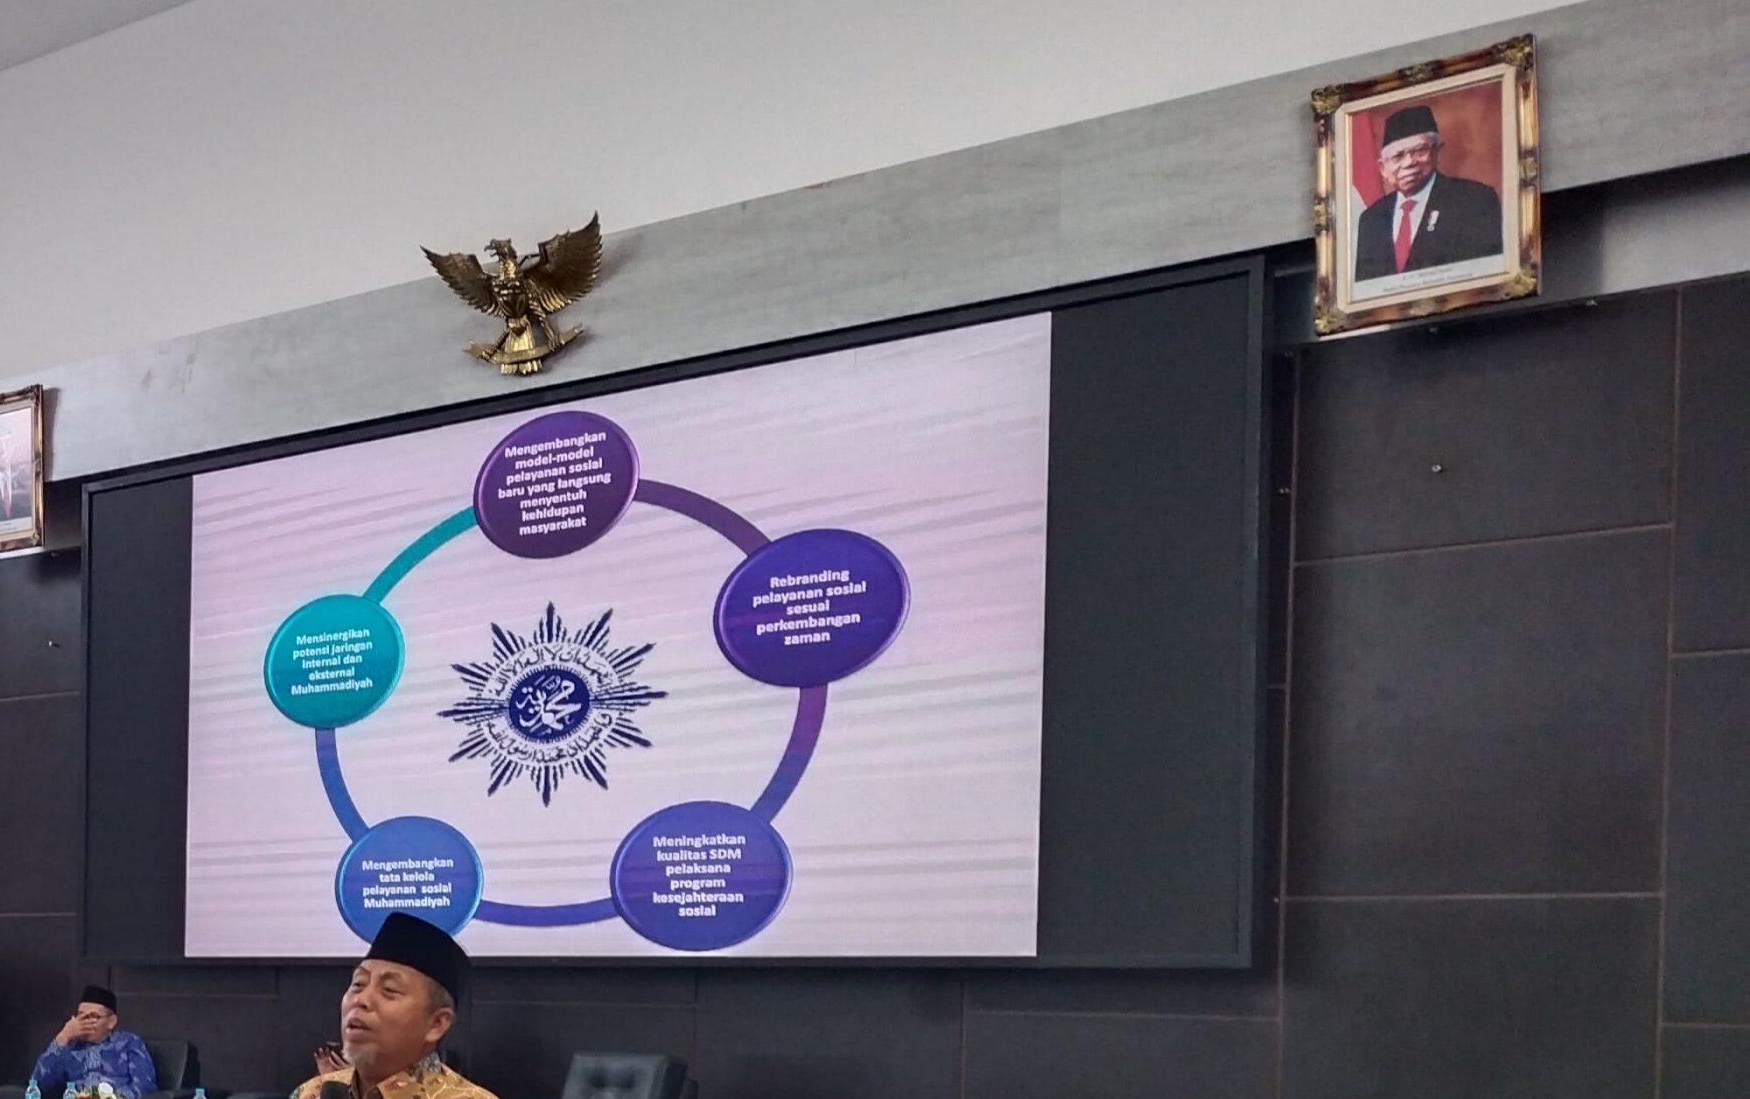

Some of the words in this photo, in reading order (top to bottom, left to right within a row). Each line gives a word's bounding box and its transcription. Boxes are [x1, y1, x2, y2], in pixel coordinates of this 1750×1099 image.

[504, 432, 607, 458] Mengembangkan
[515, 445, 594, 470] model-model
[506, 465, 567, 486] pelayanan
[568, 457, 603, 474] sosial
[498, 487, 525, 499] baru
[527, 481, 555, 496] yang
[557, 472, 612, 489] langsung
[520, 489, 587, 509] menyentuh
[522, 503, 585, 522] kehidupan
[519, 516, 587, 536] masyarakat
[770, 569, 850, 589] Rebranding
[752, 588, 823, 608] pelayanan
[826, 580, 867, 596] sosial
[756, 613, 861, 636] perkembangan
[296, 628, 370, 646] Mensinergikan
[784, 631, 831, 645] zaman
[292, 645, 329, 660] potensi
[331, 641, 373, 656] jaringan
[343, 654, 363, 664] dan
[308, 666, 355, 681] eksternal
[291, 677, 373, 696] Muhammadiyah
[652, 833, 746, 848] Meningkatkan
[656, 849, 707, 861] kualitas
[709, 848, 742, 860] SDM
[362, 857, 454, 871] Mengembangkan
[665, 862, 732, 877] pelaksana
[378, 873, 401, 882] tata
[402, 871, 435, 882] kelola
[670, 878, 726, 891] program
[362, 884, 416, 897] pelayanan
[421, 882, 452, 894] sosial
[363, 896, 450, 909] Muhammadiyah
[652, 891, 744, 905] kesejahteraan
[678, 904, 716, 917] sosial
